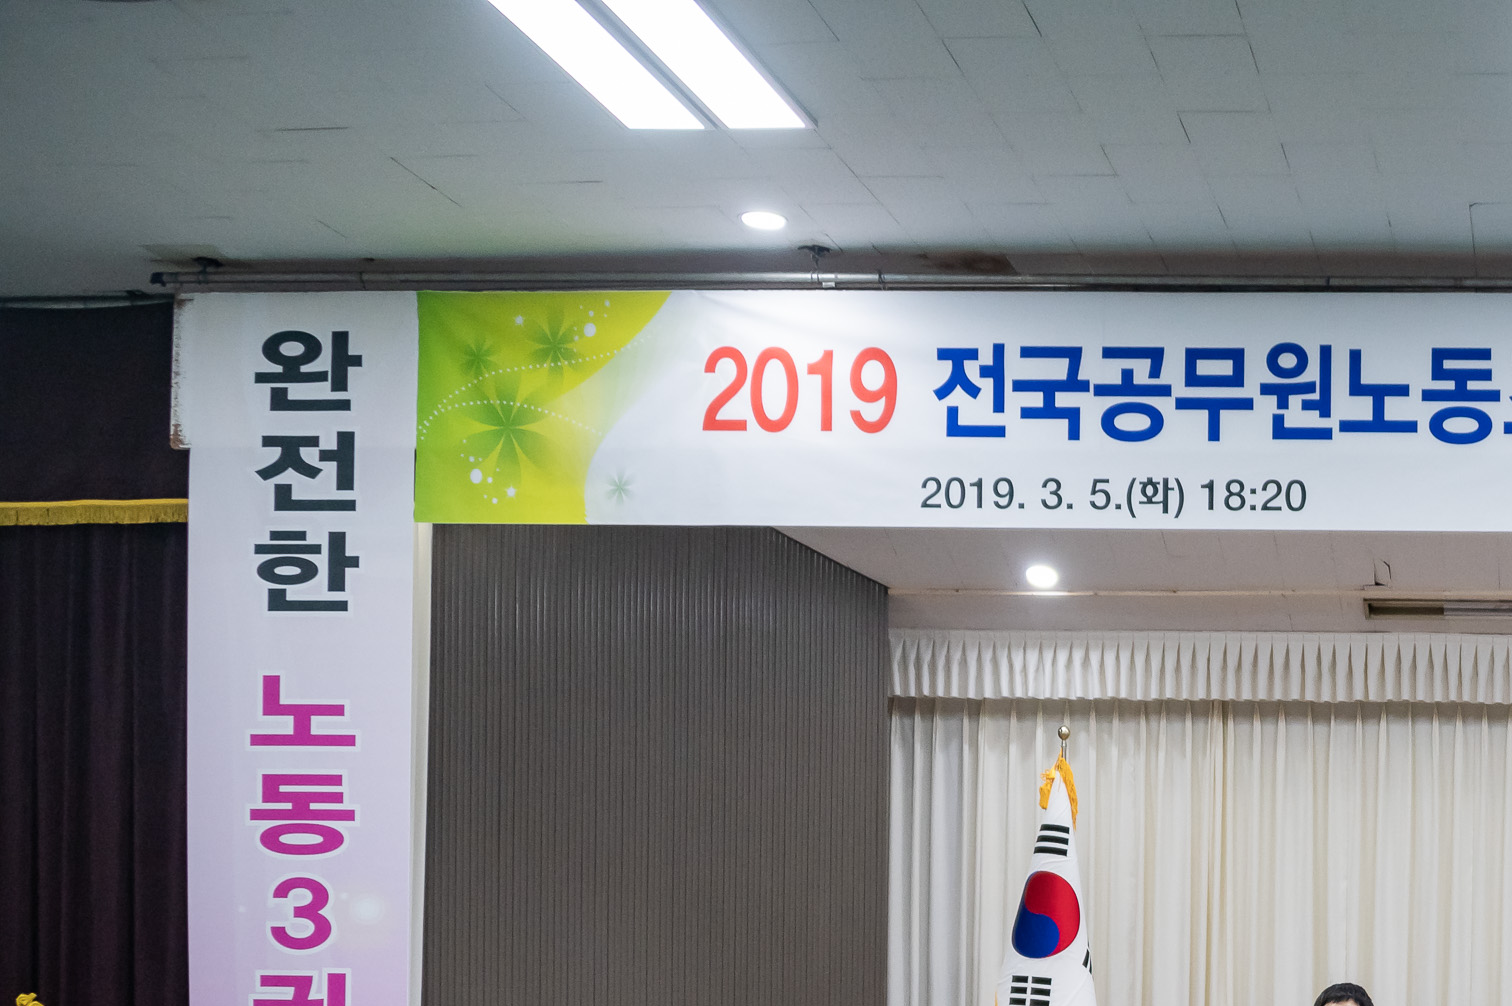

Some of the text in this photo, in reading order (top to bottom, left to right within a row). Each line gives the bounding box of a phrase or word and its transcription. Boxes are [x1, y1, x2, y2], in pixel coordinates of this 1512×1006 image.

[702, 346, 898, 434] 2019
[253, 330, 362, 613] 완전한
[920, 478, 1027, 511] 2019.
[1201, 479, 1307, 513] 18:20
